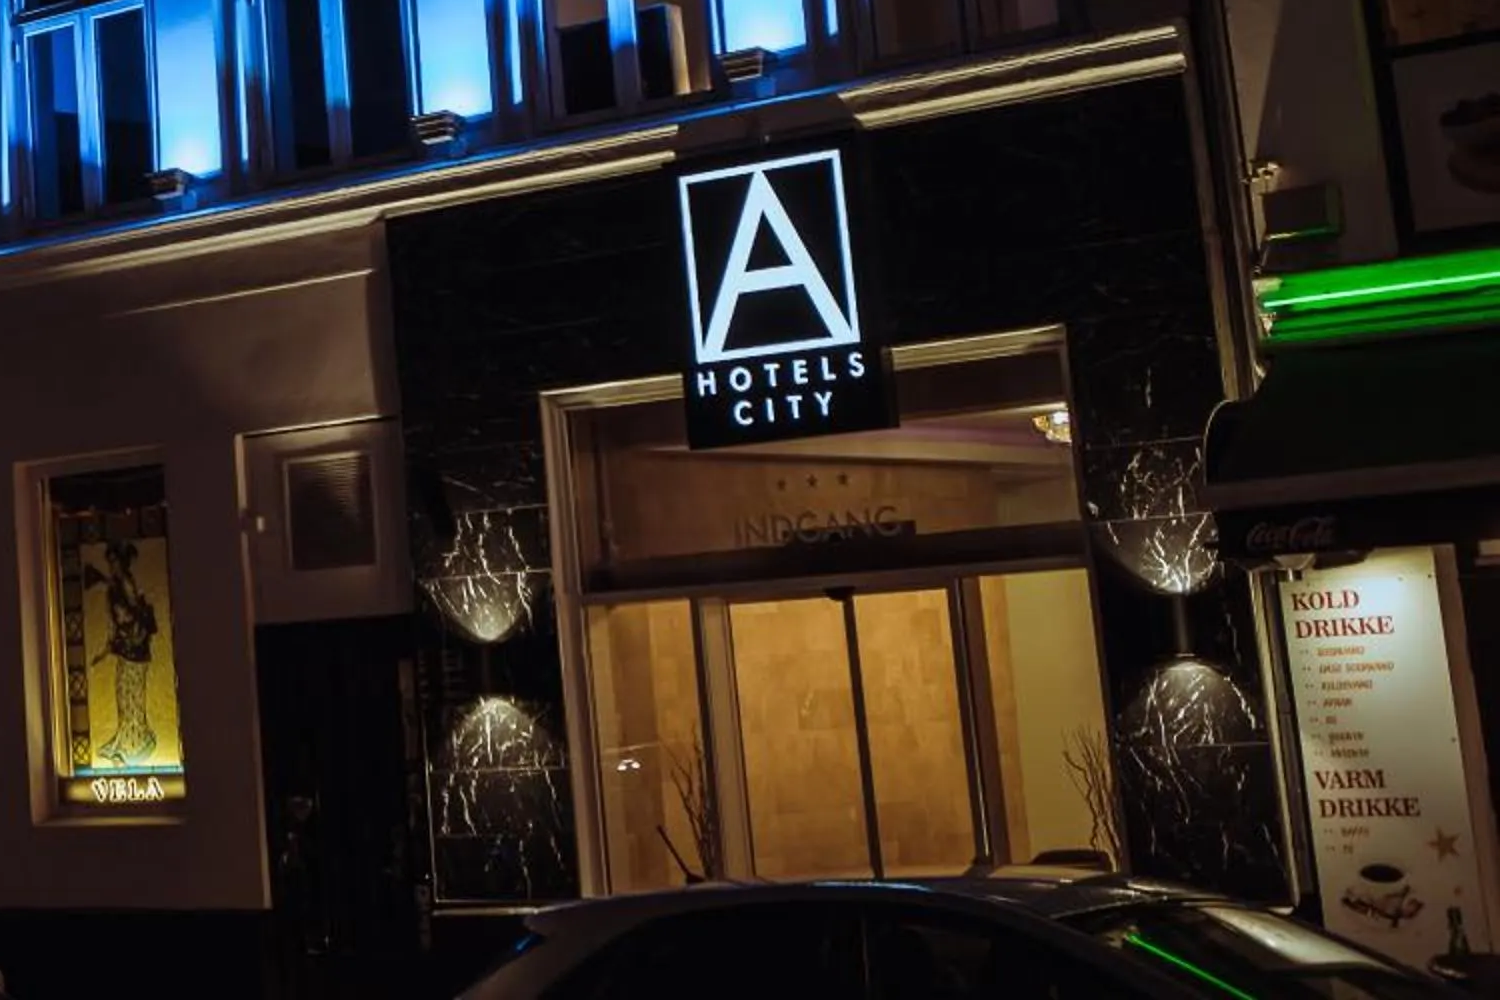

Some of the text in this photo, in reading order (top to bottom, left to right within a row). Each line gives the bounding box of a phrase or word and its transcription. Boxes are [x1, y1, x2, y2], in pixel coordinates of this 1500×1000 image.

[699, 168, 860, 362] A
[696, 350, 866, 398] HOTELS
[733, 391, 834, 427] CITY
[734, 506, 901, 546] INDGANG
[1291, 590, 1359, 611] KOLD
[1295, 615, 1394, 639] DRIKKE
[91, 777, 164, 803] VELA
[1314, 769, 1386, 790] VARM
[1319, 797, 1421, 818] DRIKKE
